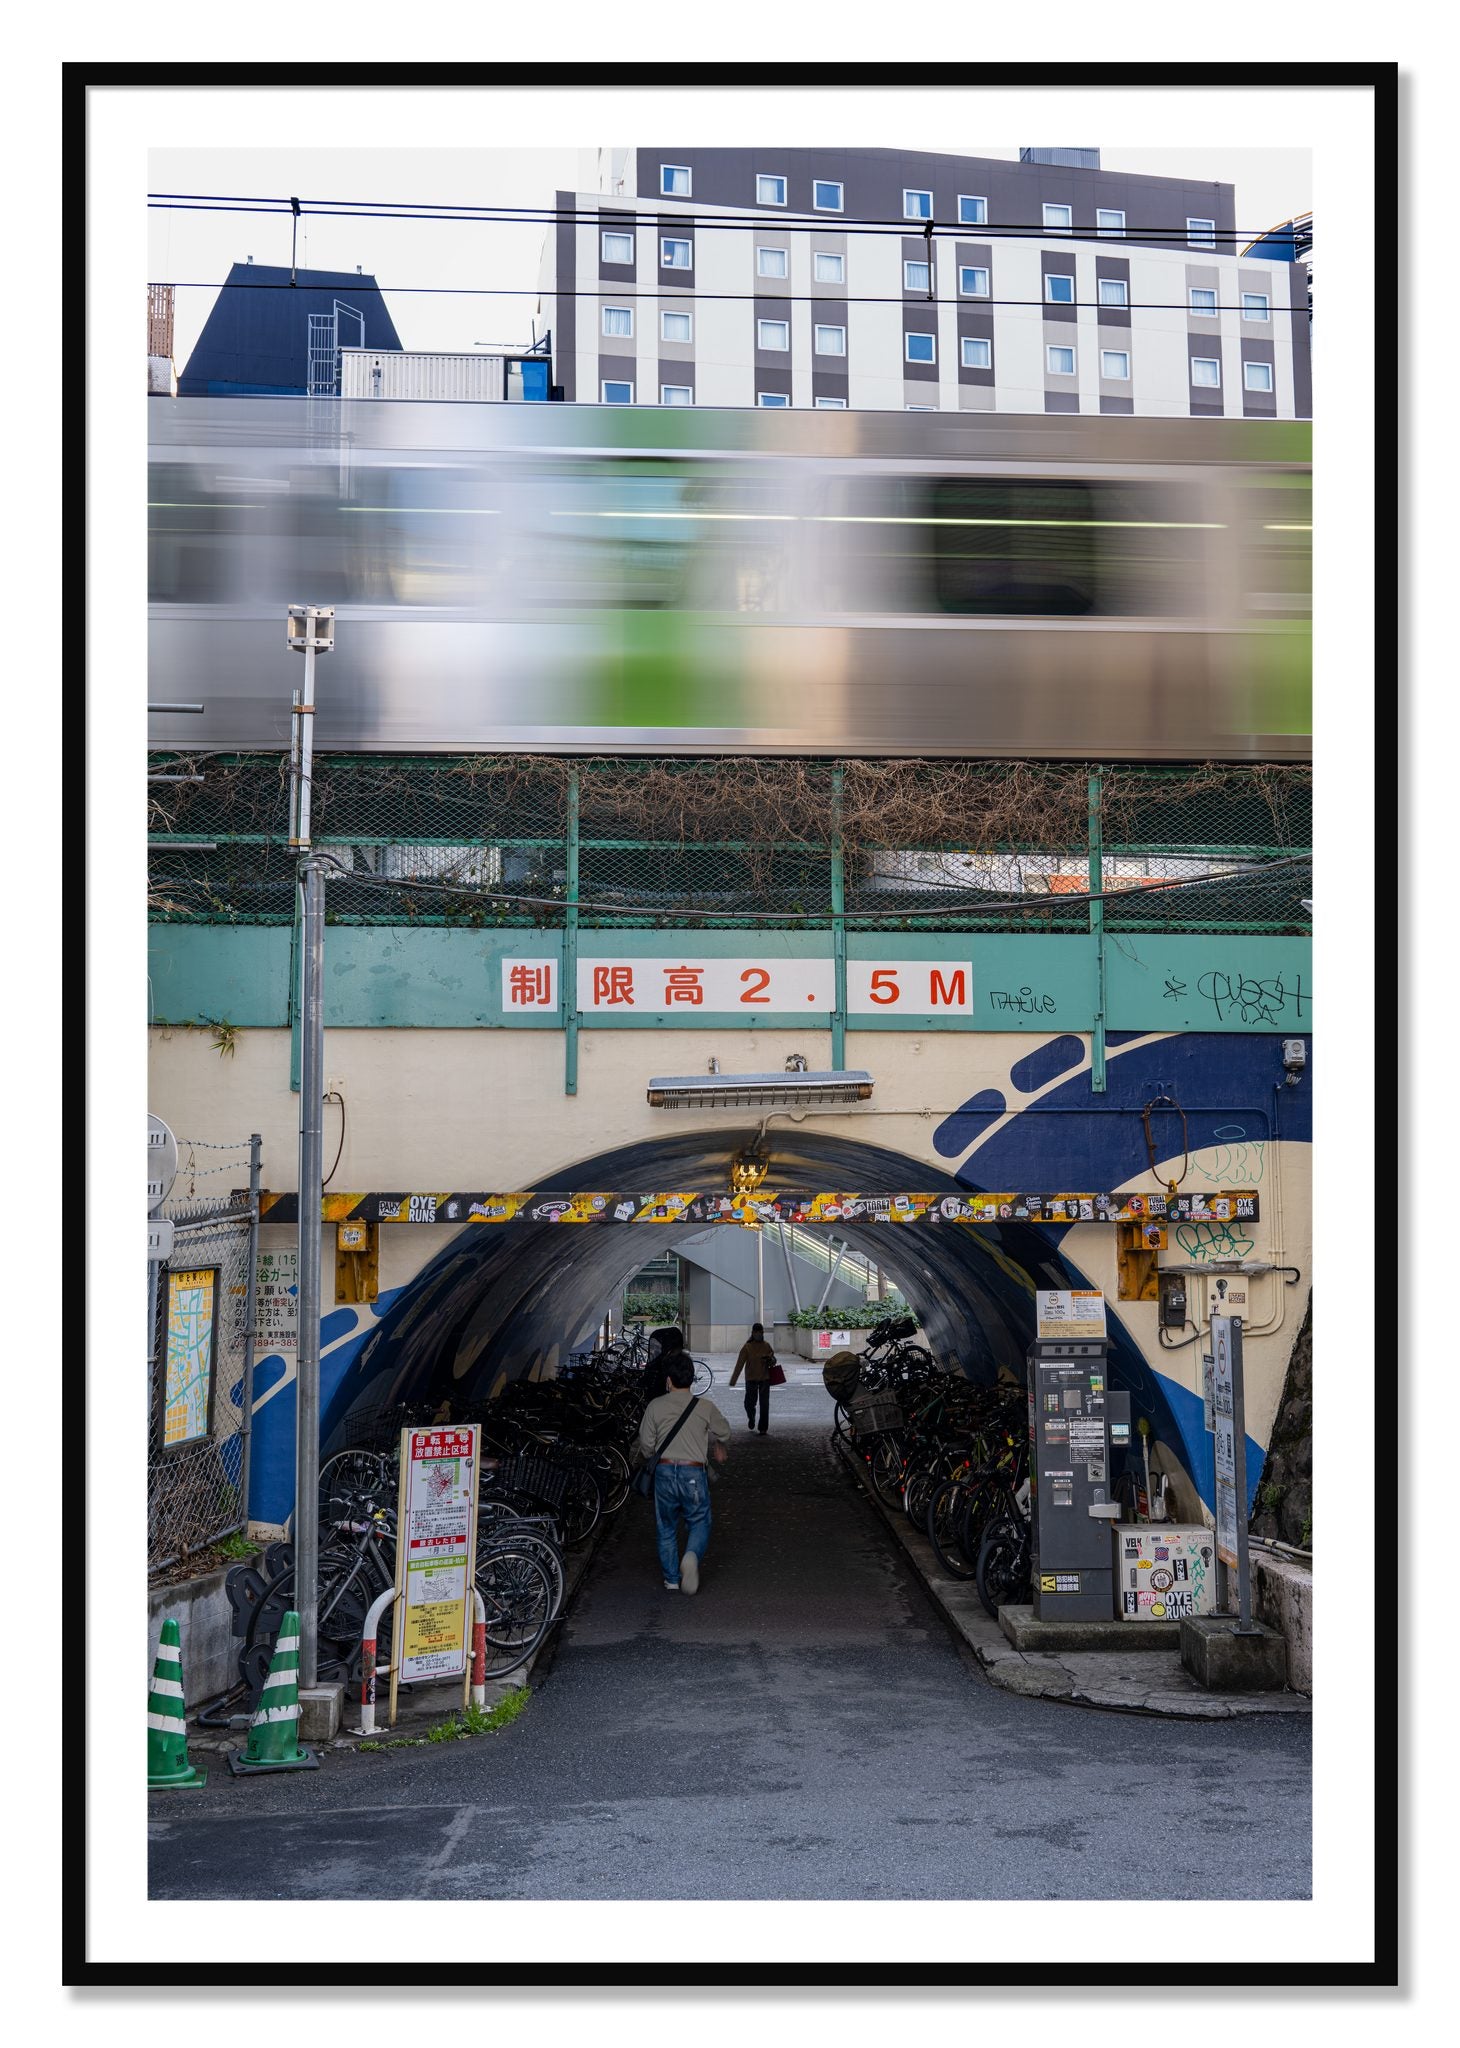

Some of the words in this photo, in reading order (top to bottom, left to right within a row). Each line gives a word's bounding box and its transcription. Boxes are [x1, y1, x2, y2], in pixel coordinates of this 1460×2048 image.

[410, 1195, 437, 1210] OYE
[1236, 1198, 1254, 1207] OYE
[408, 1209, 436, 1223] RUNS
[1237, 1206, 1254, 1216] RUNS
[1165, 1592, 1192, 1606] OYE
[1166, 1605, 1193, 1619] RUNS
